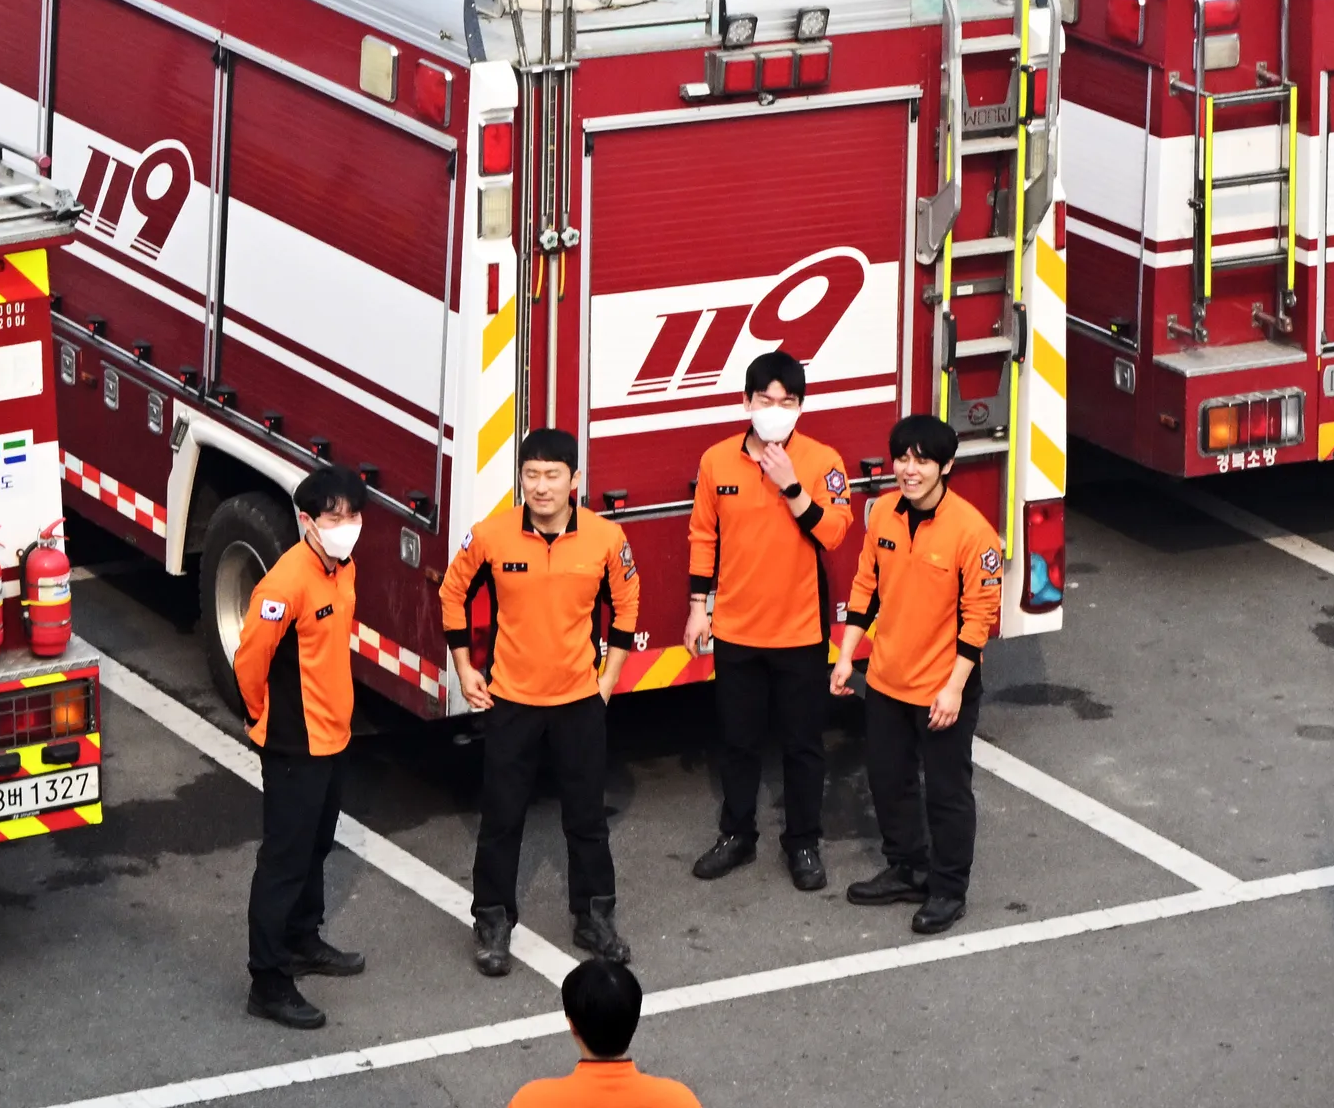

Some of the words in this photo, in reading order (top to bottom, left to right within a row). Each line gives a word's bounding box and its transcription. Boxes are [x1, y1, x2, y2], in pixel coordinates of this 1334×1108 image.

[68, 144, 192, 261] 119
[626, 254, 866, 396] 119
[1216, 447, 1278, 474] 경북소방
[31, 772, 91, 811] 1327
